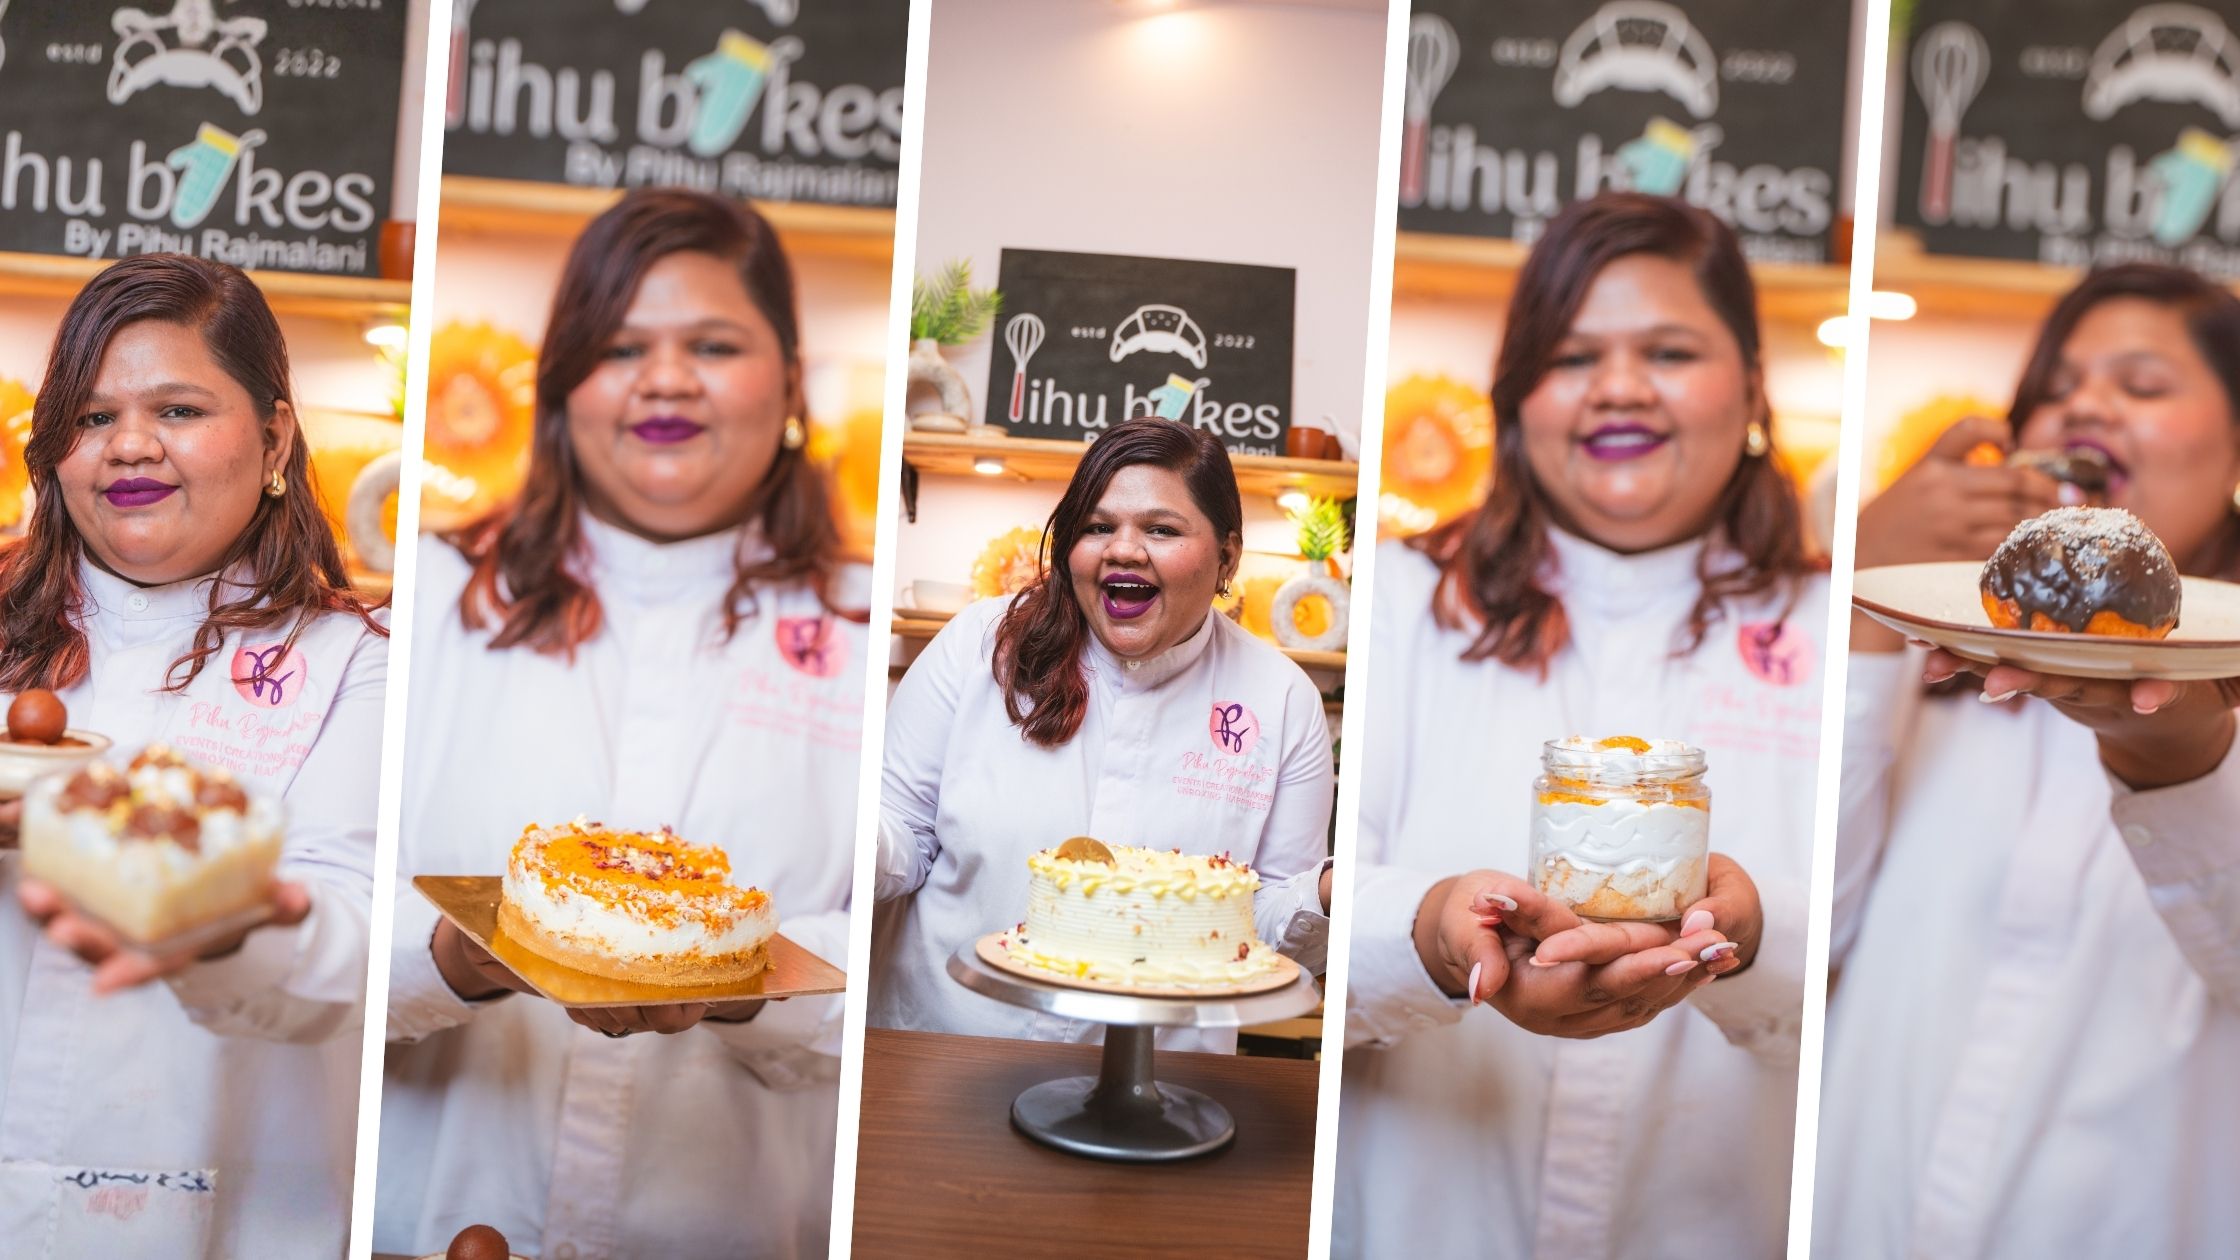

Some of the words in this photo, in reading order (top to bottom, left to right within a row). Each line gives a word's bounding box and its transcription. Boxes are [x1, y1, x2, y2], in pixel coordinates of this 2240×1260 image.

[46, 43, 102, 64] estd
[274, 47, 341, 78] 2022
[0, 130, 106, 216] hu
[64, 219, 111, 258] By
[116, 222, 193, 257] Pihu
[1071, 326, 1106, 339] estd
[1213, 333, 1255, 349] 2022
